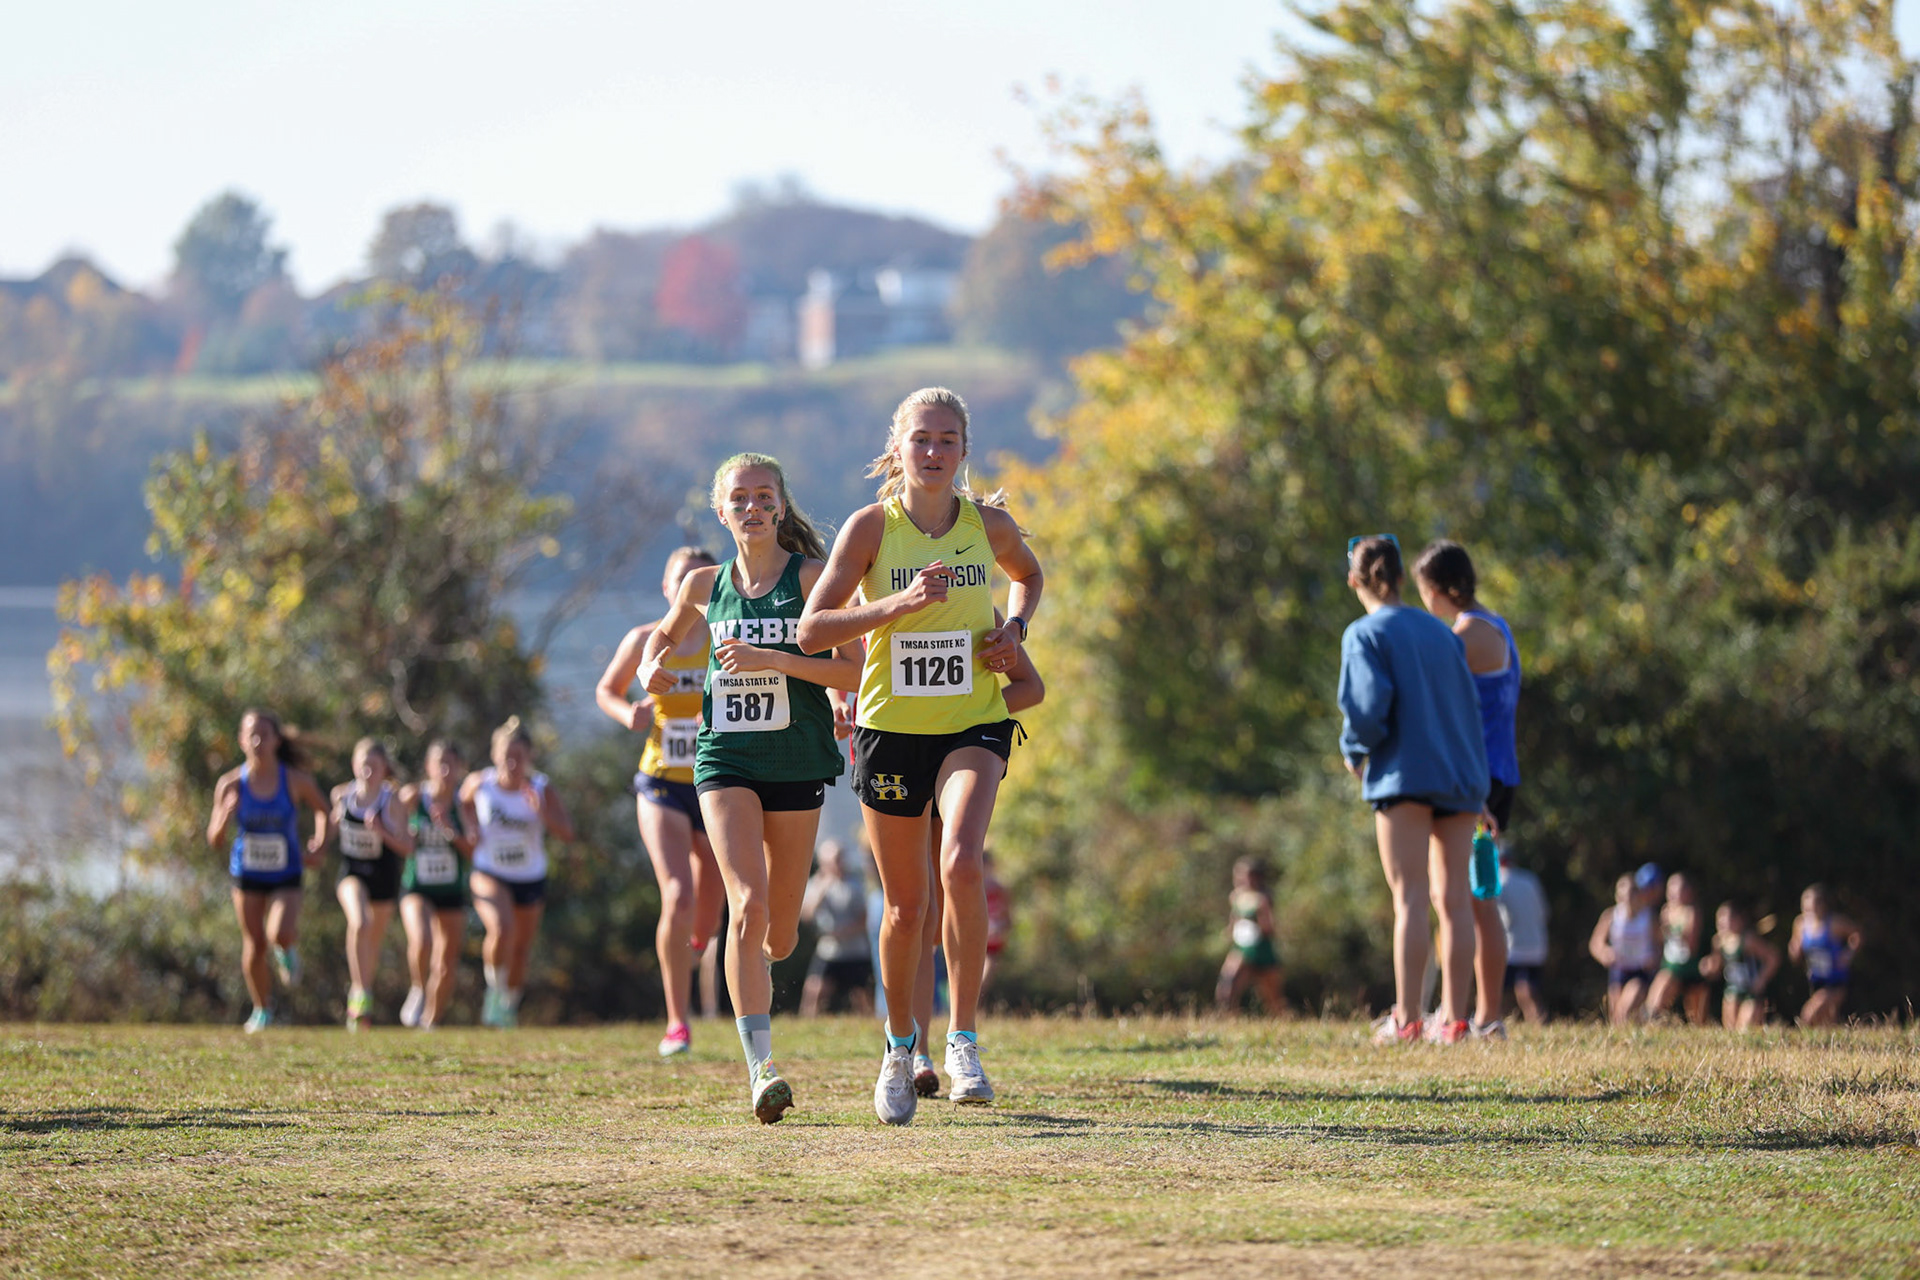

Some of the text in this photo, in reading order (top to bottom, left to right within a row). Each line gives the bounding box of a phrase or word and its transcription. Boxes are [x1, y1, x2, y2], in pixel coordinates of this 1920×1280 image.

[900, 638, 965, 649] TMSAA STATE XC
[900, 655, 964, 686] 1126
[719, 676, 779, 687] TMSAA STATE XC
[726, 693, 775, 722] 587
